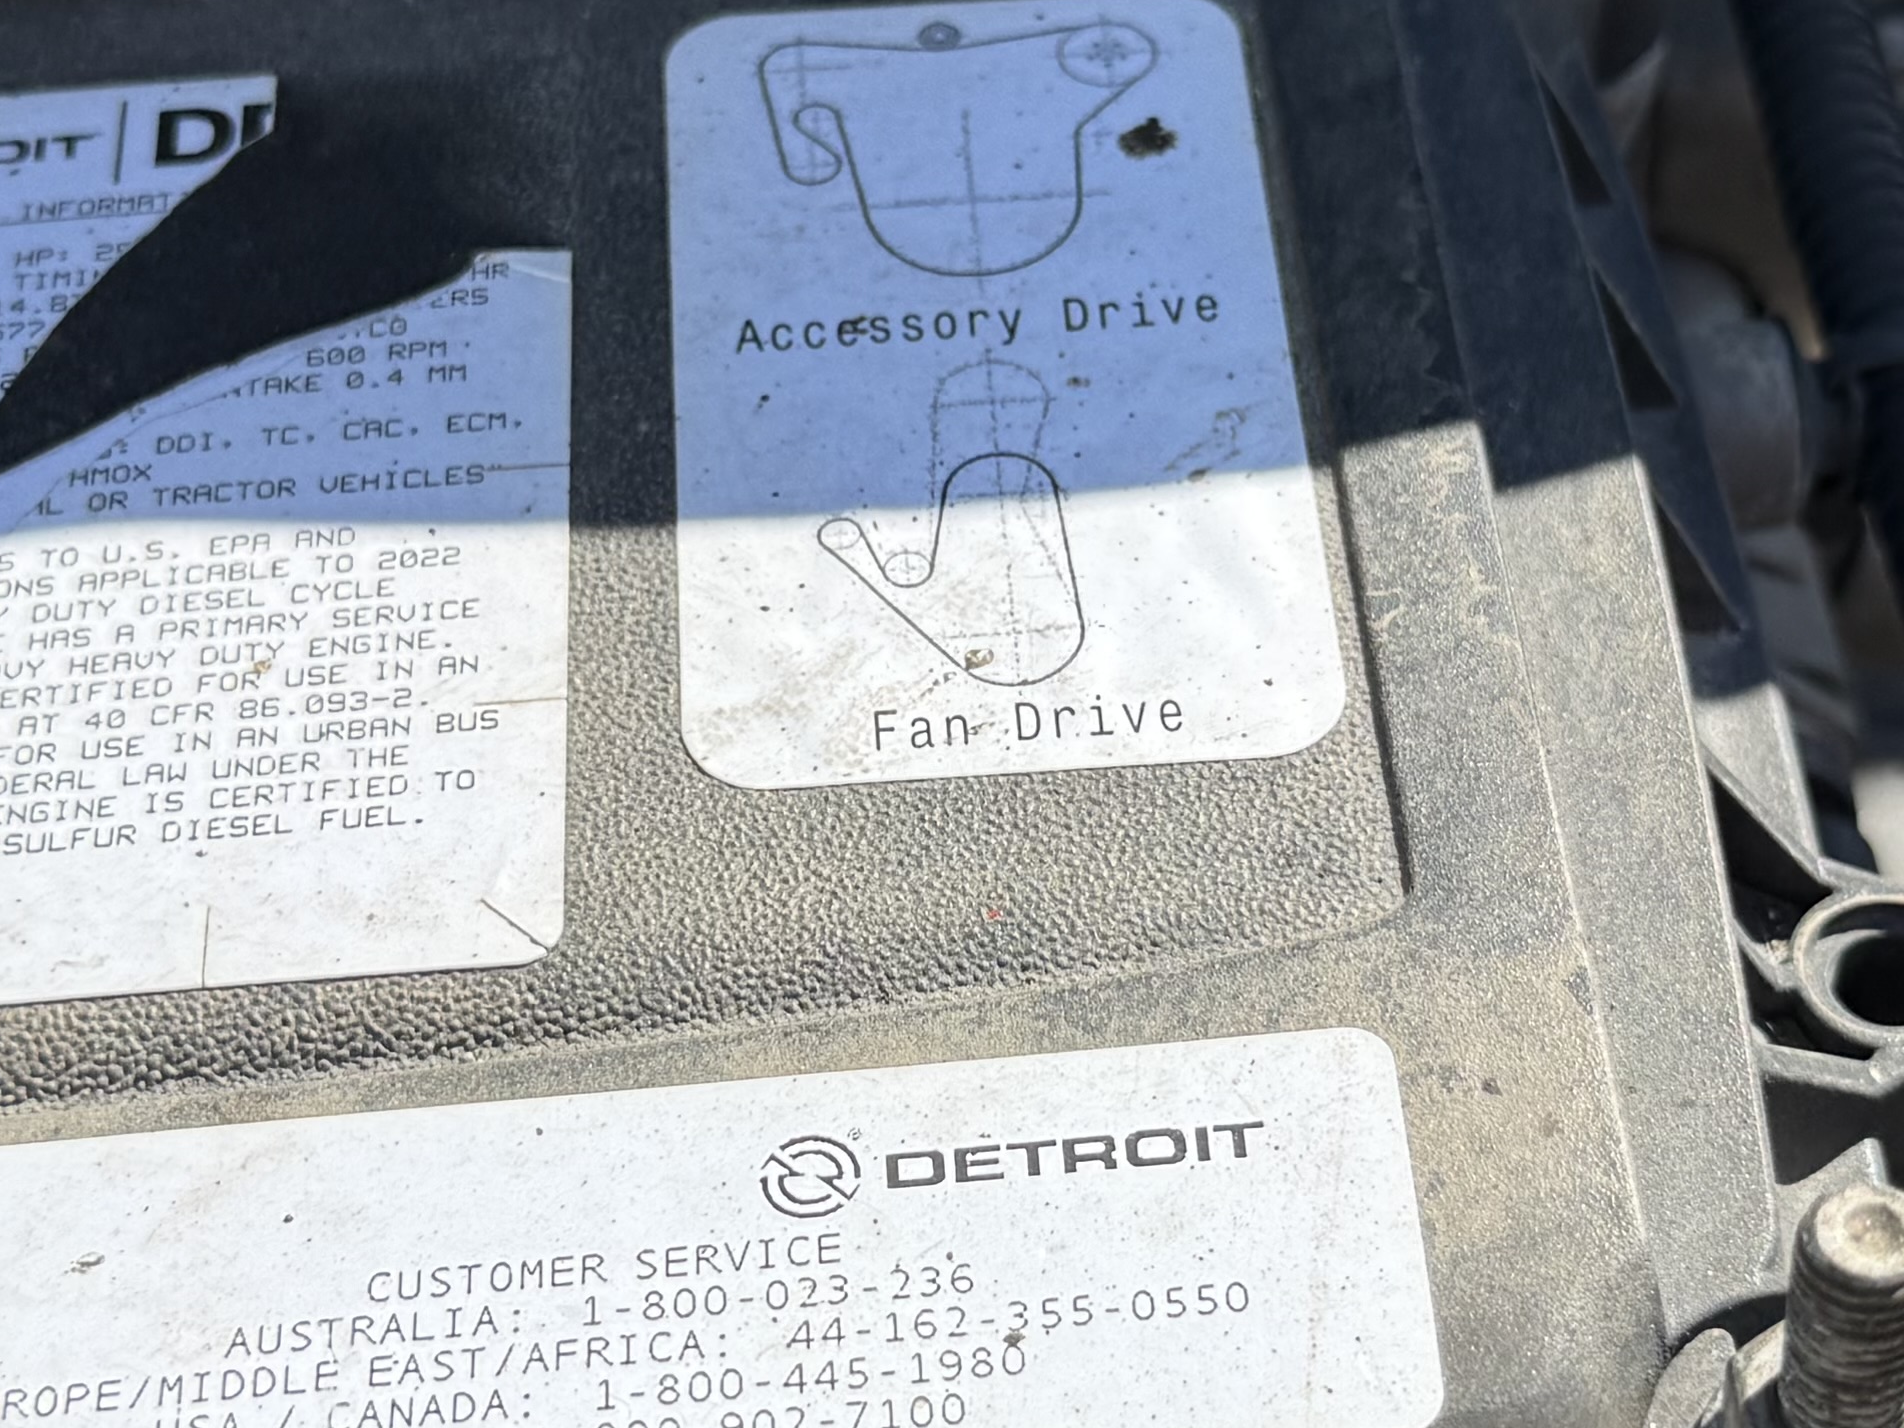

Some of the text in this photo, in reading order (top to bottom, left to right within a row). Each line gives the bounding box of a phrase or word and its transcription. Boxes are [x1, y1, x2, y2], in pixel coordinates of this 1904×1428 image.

[22, 192, 175, 222] INFORMAT
[12, 268, 99, 293] TIMI
[14, 248, 68, 267] HP:
[734, 288, 1223, 359] Accessory Drive
[306, 345, 366, 368] 600
[387, 338, 447, 362] RPM
[345, 368, 404, 390] 0.4
[428, 363, 467, 384] MM
[86, 491, 128, 514] OR
[151, 478, 296, 509] TRACTOR
[38, 548, 79, 570] TO
[101, 540, 181, 565] U.S.
[208, 533, 270, 557] EPA
[294, 526, 355, 550] AND
[76, 557, 290, 595] APPLICABLE
[314, 552, 354, 575] TO
[377, 544, 460, 570] 2022
[26, 628, 92, 652] HAS
[113, 624, 135, 645] A
[157, 610, 308, 642] PRIMARY
[331, 596, 480, 630] SERVICE
[29, 598, 117, 624] DUTY
[137, 586, 266, 617] DIESEL
[289, 576, 395, 605] CYCLE
[67, 648, 176, 677] HEAVY
[198, 639, 285, 667] DUTY
[307, 626, 452, 659] ENGINE.
[196, 670, 259, 695] FOR
[283, 662, 348, 689] USE
[375, 657, 414, 681] IN
[437, 652, 479, 677] AN
[16, 714, 60, 737] AT
[83, 708, 126, 732] 40
[149, 701, 214, 727] CFR
[237, 684, 429, 721] 86.093-2.
[79, 736, 145, 762] USE
[173, 731, 212, 754] IN
[235, 725, 278, 749] AN
[302, 714, 411, 745] URBAN
[435, 708, 499, 734] BUS
[871, 691, 1187, 752] Fan Drive
[121, 761, 187, 787] LAW
[210, 750, 321, 781] UNDER
[345, 743, 409, 771] THE
[144, 791, 184, 815] IS
[208, 772, 408, 811] CERTIFIED
[433, 768, 475, 792] TO
[1, 824, 136, 857] SULFUR
[159, 811, 294, 845] DIESEL
[318, 801, 424, 832] FUEL.
[883, 1119, 1269, 1190] DETROIT
[367, 1232, 843, 1304] CUSTOMER SERVICE
[223, 1262, 976, 1359] AUSTRALIA: 1-800-023-236
[368, 1325, 729, 1389] EAST/AFRICA:
[786, 1280, 1253, 1353] 44-162-355-0550
[594, 1342, 1027, 1412] 1-800-445-1980
